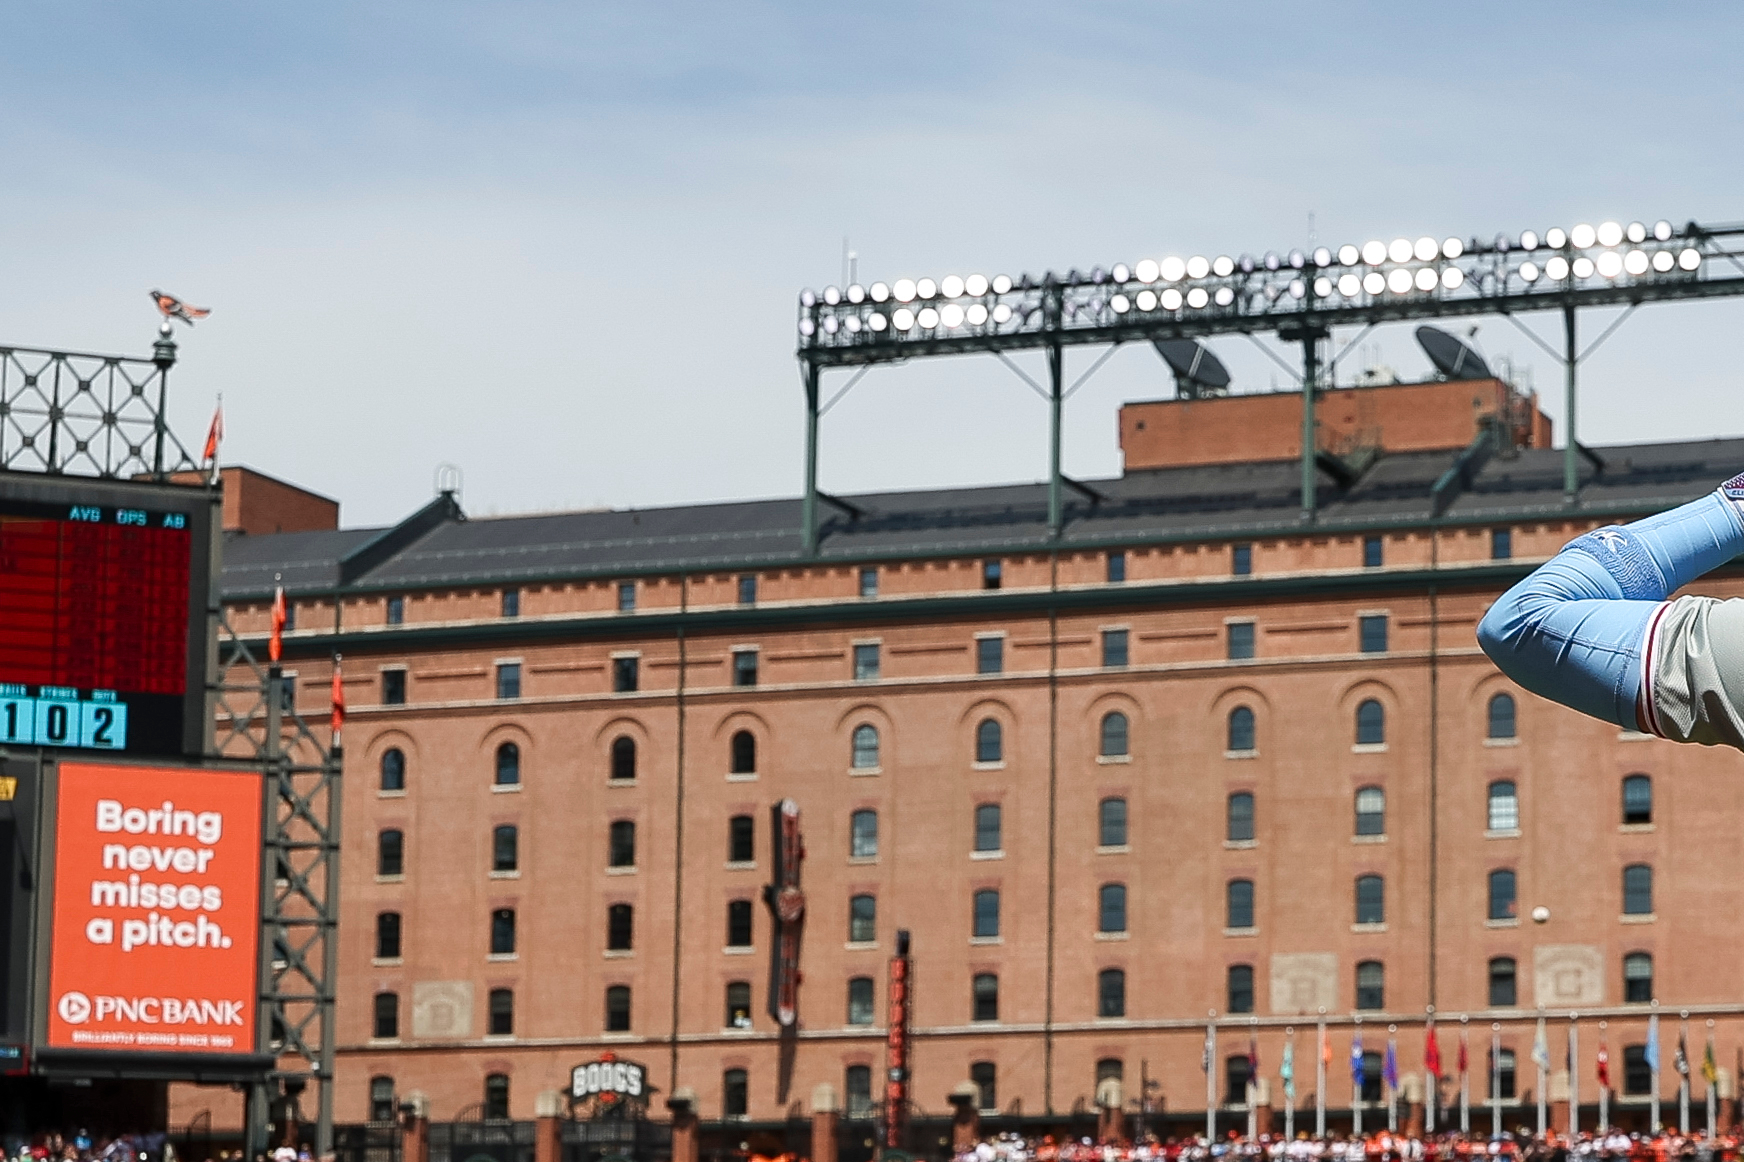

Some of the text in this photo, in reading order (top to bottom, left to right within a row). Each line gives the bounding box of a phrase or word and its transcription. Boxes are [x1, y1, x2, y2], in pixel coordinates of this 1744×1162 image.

[69, 505, 186, 529] AVG OPS AB
[5, 701, 17, 739] 1
[47, 704, 67, 742] 0
[93, 706, 113, 744] 2
[96, 799, 222, 845] Boring
[103, 843, 215, 874] never
[91, 873, 222, 911] misses
[86, 911, 233, 952] a pitch.
[94, 996, 244, 1026] PNC BANK
